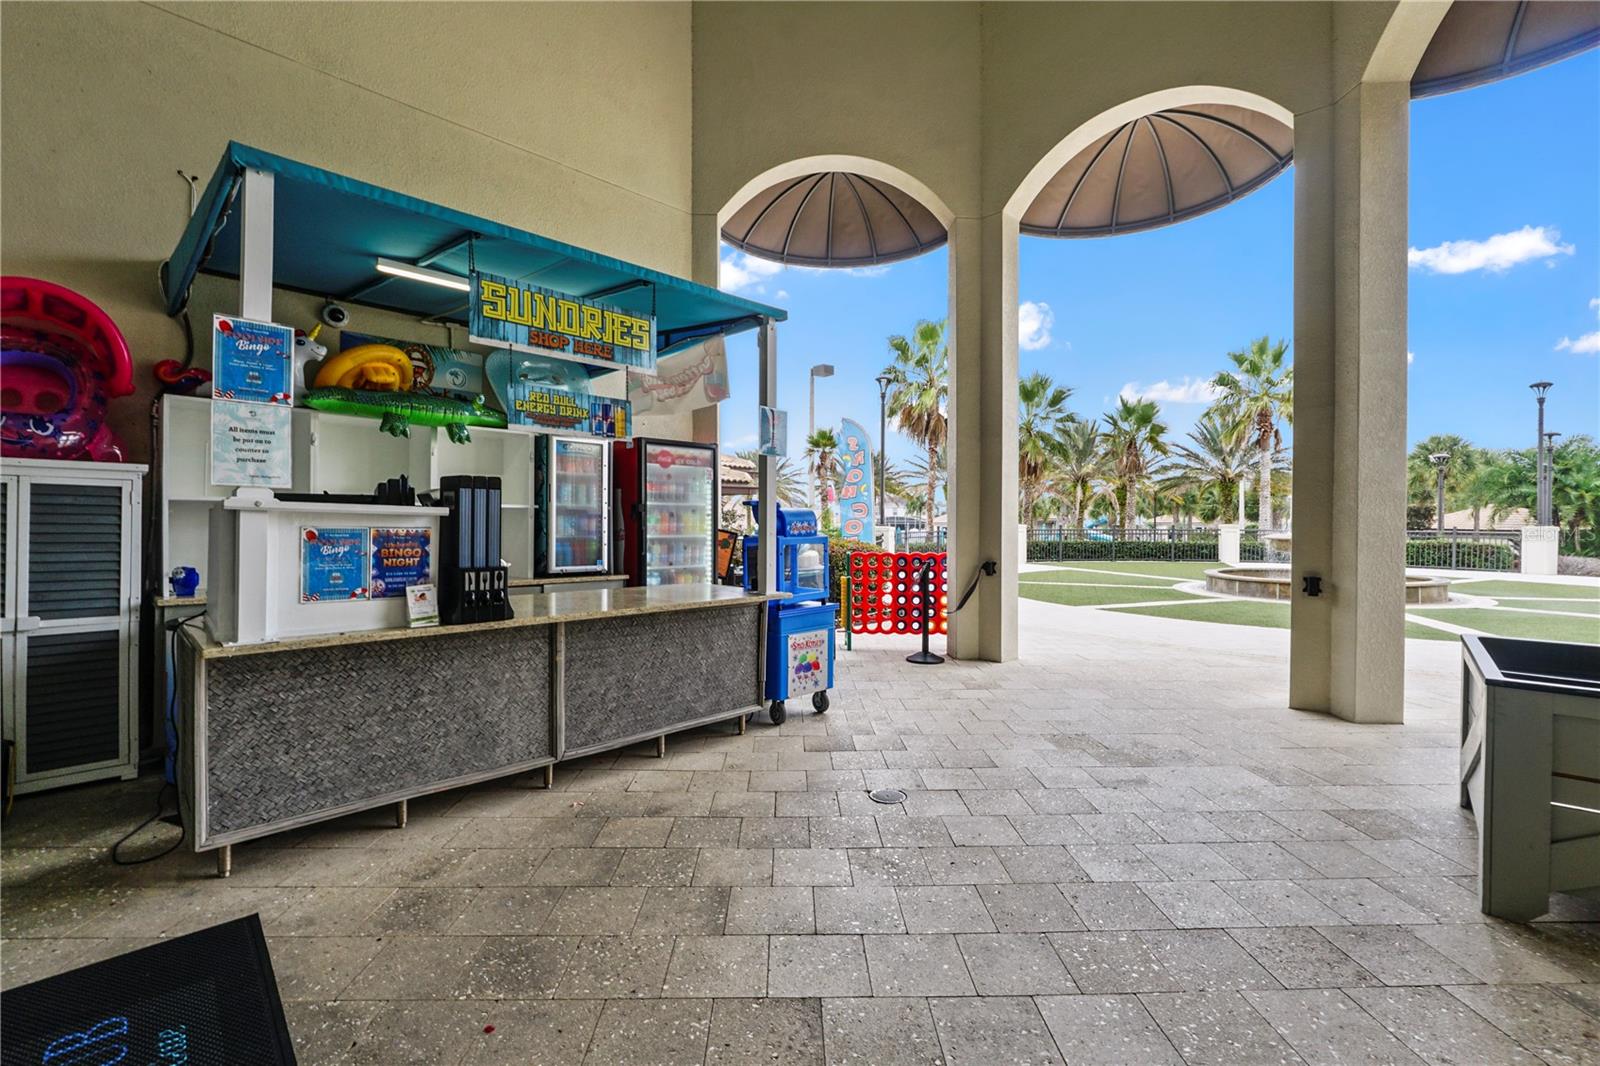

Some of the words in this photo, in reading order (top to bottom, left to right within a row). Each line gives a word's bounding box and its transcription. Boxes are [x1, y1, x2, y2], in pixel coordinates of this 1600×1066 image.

[480, 279, 650, 351] SUNDRIES
[235, 339, 271, 356] Bingo
[529, 330, 570, 350] SHOP
[573, 338, 613, 359] HERE
[529, 391, 549, 402] RED
[553, 395, 577, 407] BULL
[515, 400, 556, 415] ENERGY
[560, 406, 590, 419] DRINK
[320, 545, 350, 557] Bingo
[381, 548, 422, 557] BINGO
[383, 558, 420, 567] NIGHT
